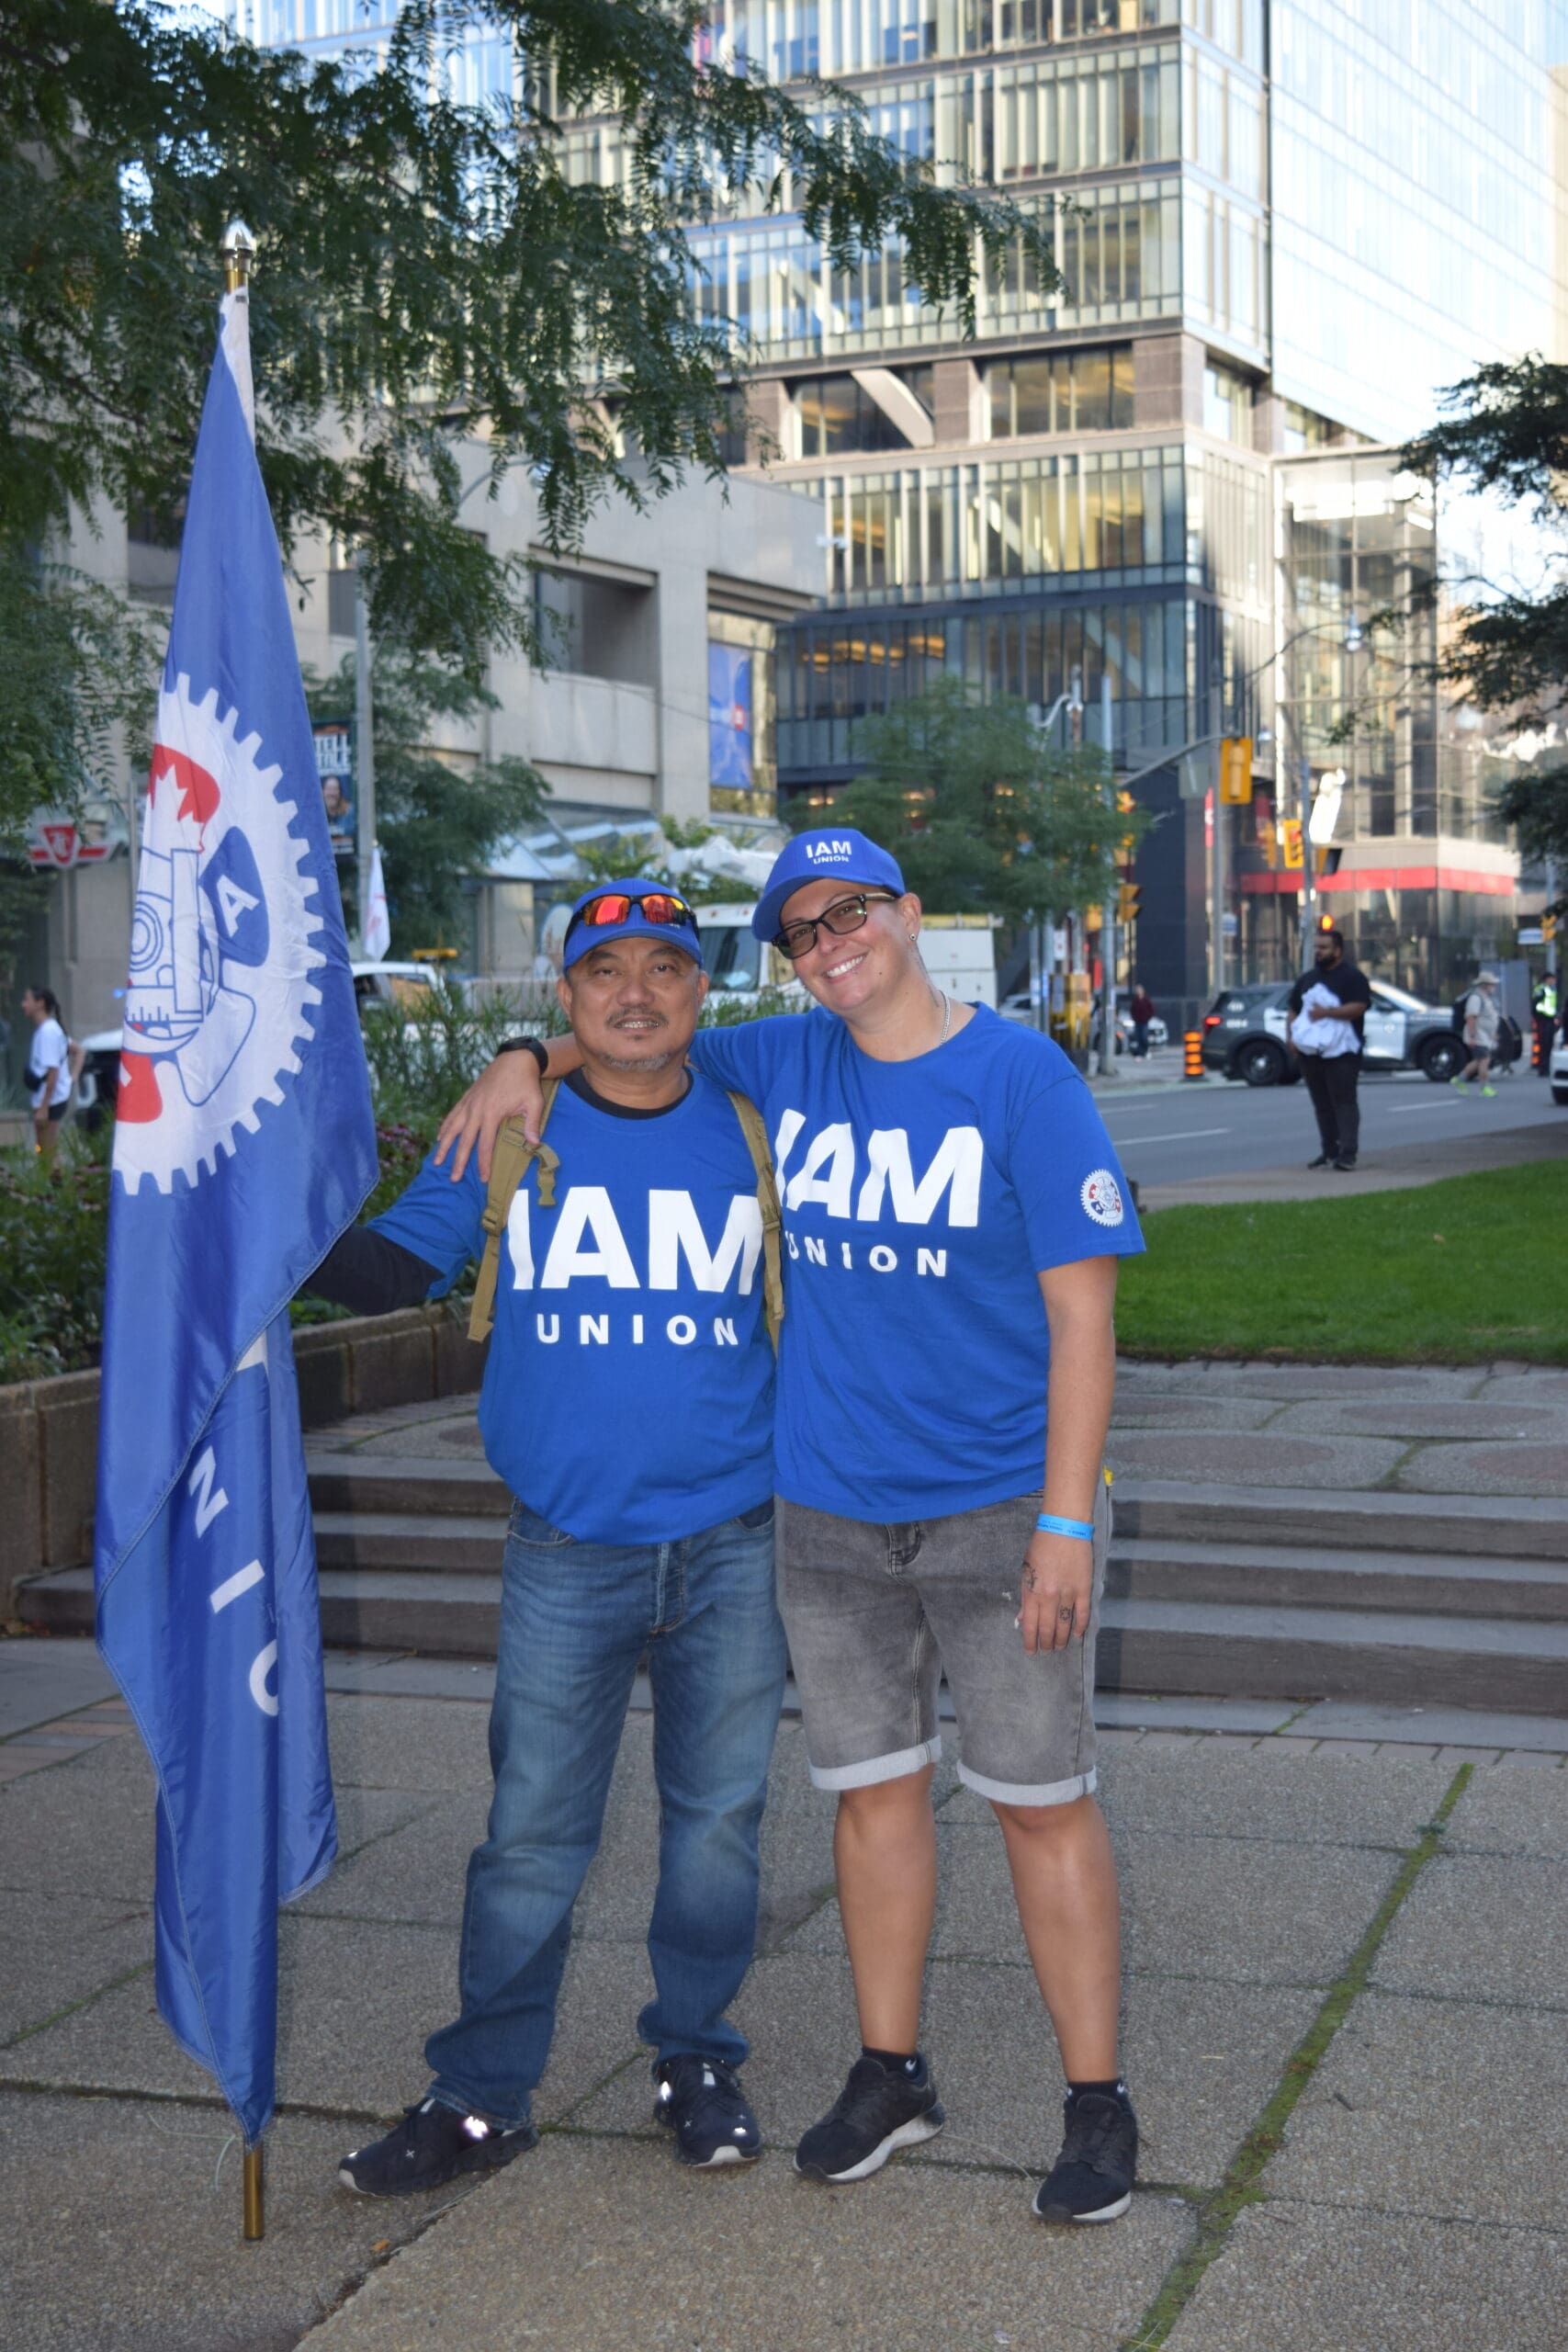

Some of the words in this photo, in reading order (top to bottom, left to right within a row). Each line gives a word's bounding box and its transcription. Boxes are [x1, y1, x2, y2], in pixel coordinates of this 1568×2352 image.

[806, 841, 852, 858] IAM
[813, 854, 850, 865] UNION
[216, 874, 260, 937] A
[774, 1108, 984, 1227] IAM
[507, 1186, 764, 1295] IAM
[784, 1230, 947, 1277] UNION
[536, 1313, 739, 1346] UNION
